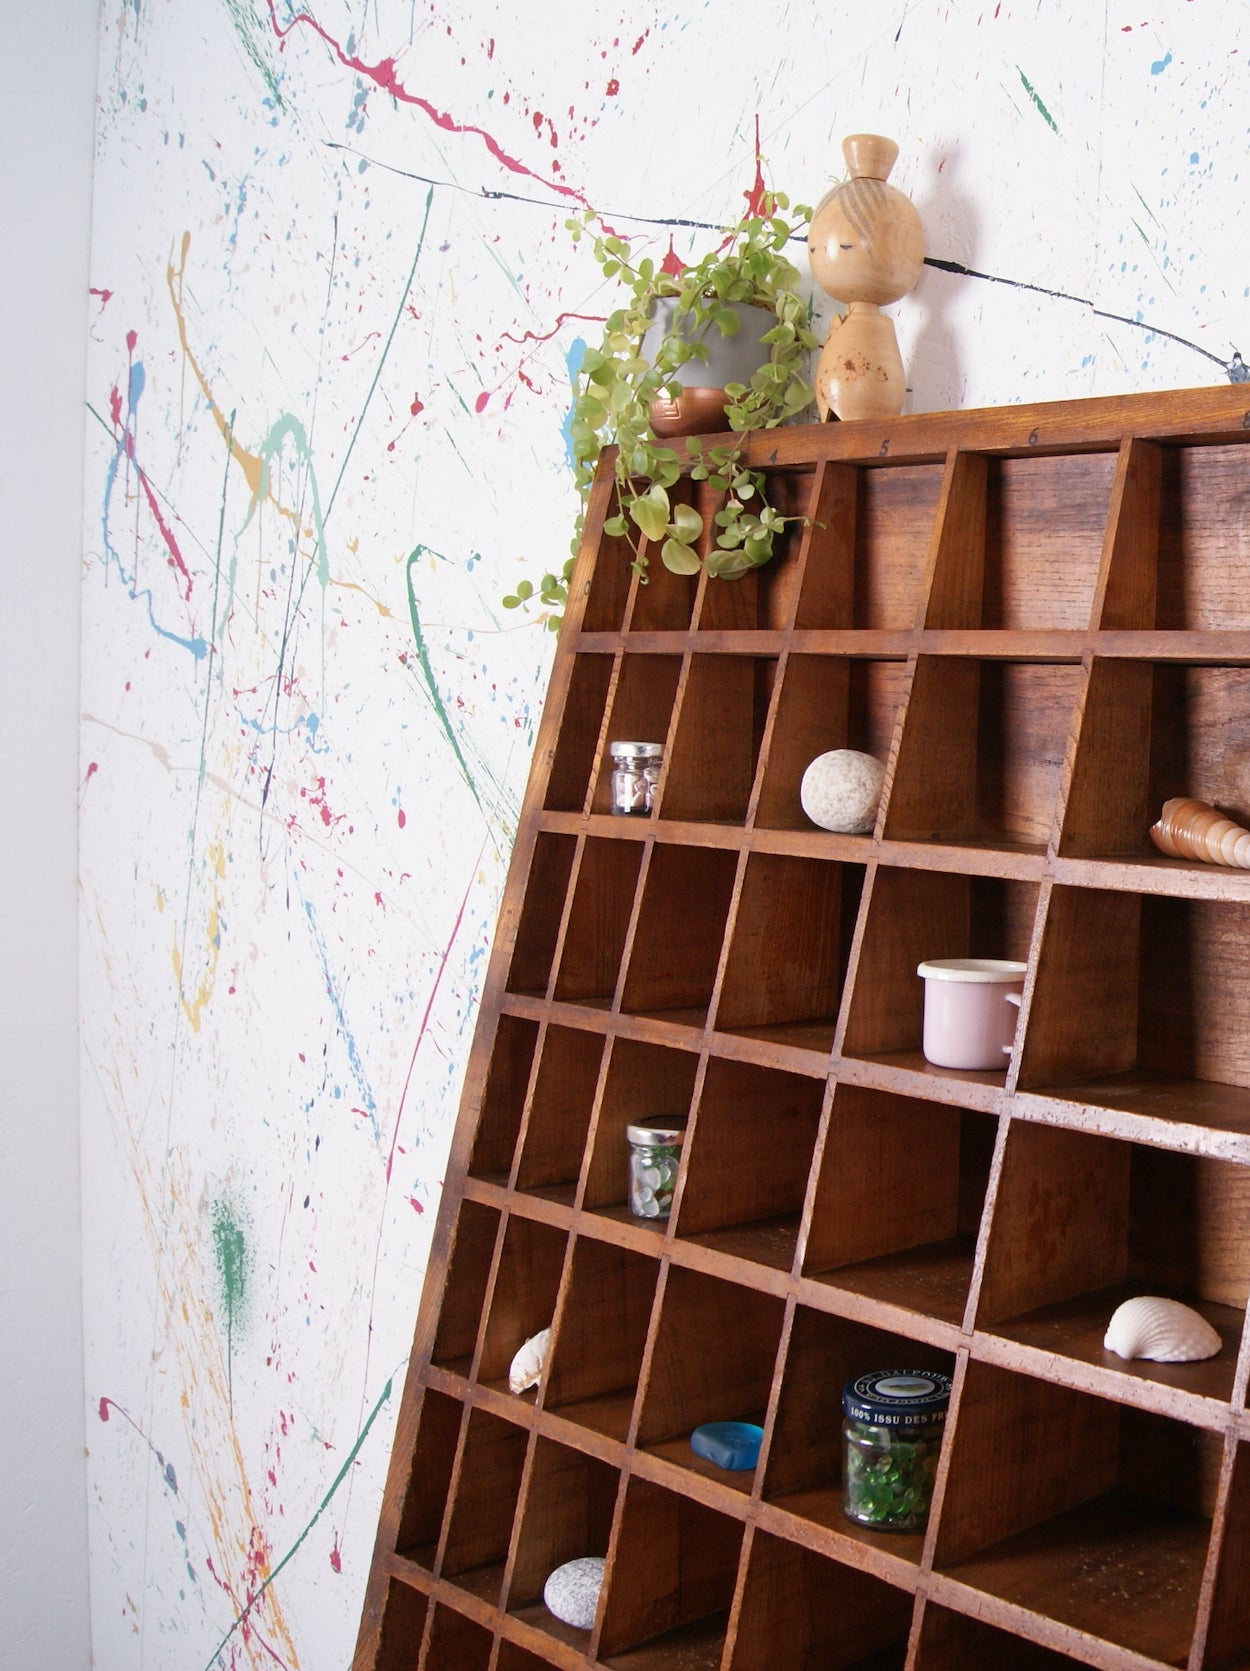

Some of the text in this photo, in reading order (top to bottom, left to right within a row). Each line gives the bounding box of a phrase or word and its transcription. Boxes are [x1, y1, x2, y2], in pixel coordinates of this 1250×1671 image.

[1028, 426, 1040, 446] 6
[769, 448, 778, 464] 4
[878, 439, 890, 457] 5
[851, 1406, 947, 1425] 100% ISSU DES FR
